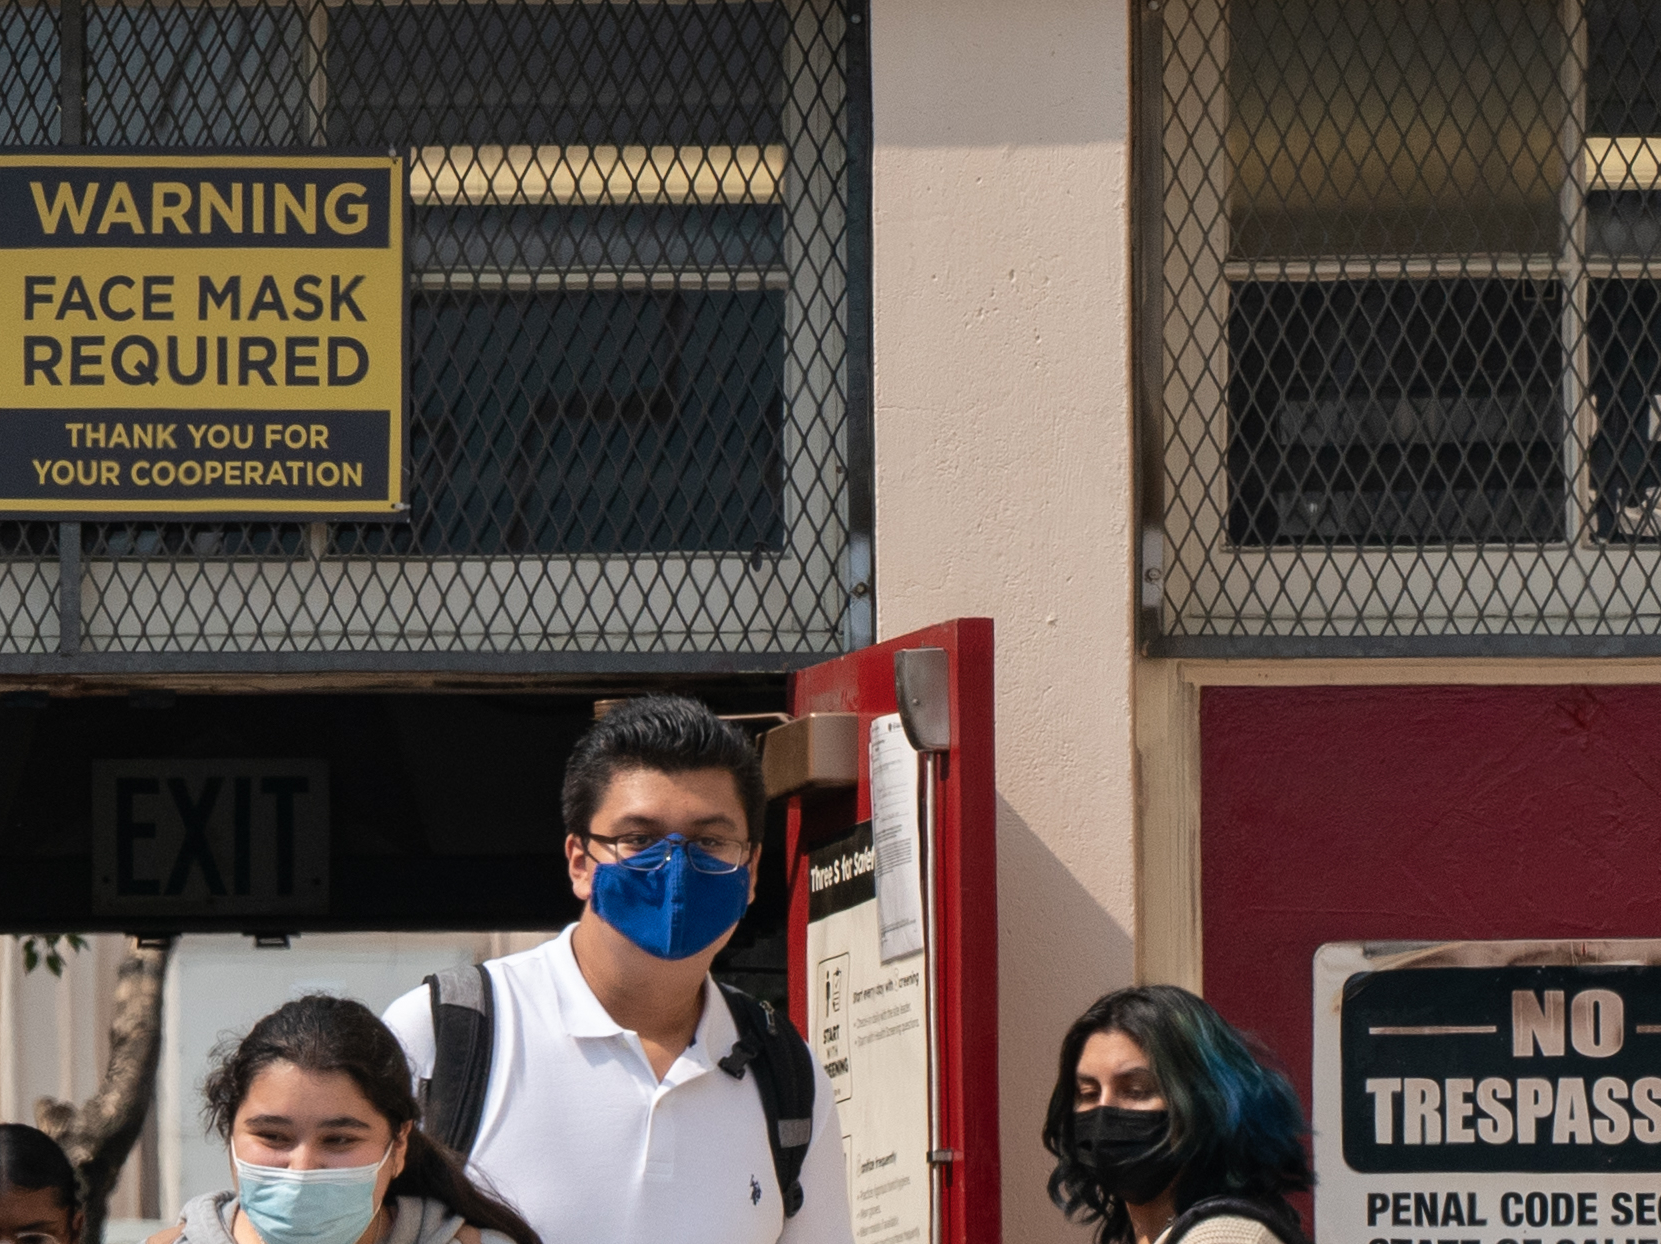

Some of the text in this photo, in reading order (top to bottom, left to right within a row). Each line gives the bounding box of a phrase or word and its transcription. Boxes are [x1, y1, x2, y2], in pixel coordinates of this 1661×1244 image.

[30, 181, 369, 235] WARNING
[23, 275, 367, 321] FACE MASK
[23, 335, 369, 387] REQUIRED
[66, 423, 329, 450] THANK YOU FOR
[33, 460, 363, 487] YOUR COOPERATION
[116, 776, 309, 896] EXIT
[811, 845, 875, 892] Three S for Safet
[1512, 989, 1624, 1058] NO
[1366, 1077, 1661, 1144] TRESPASS
[1367, 1192, 1661, 1227] PENAL CODE SE
